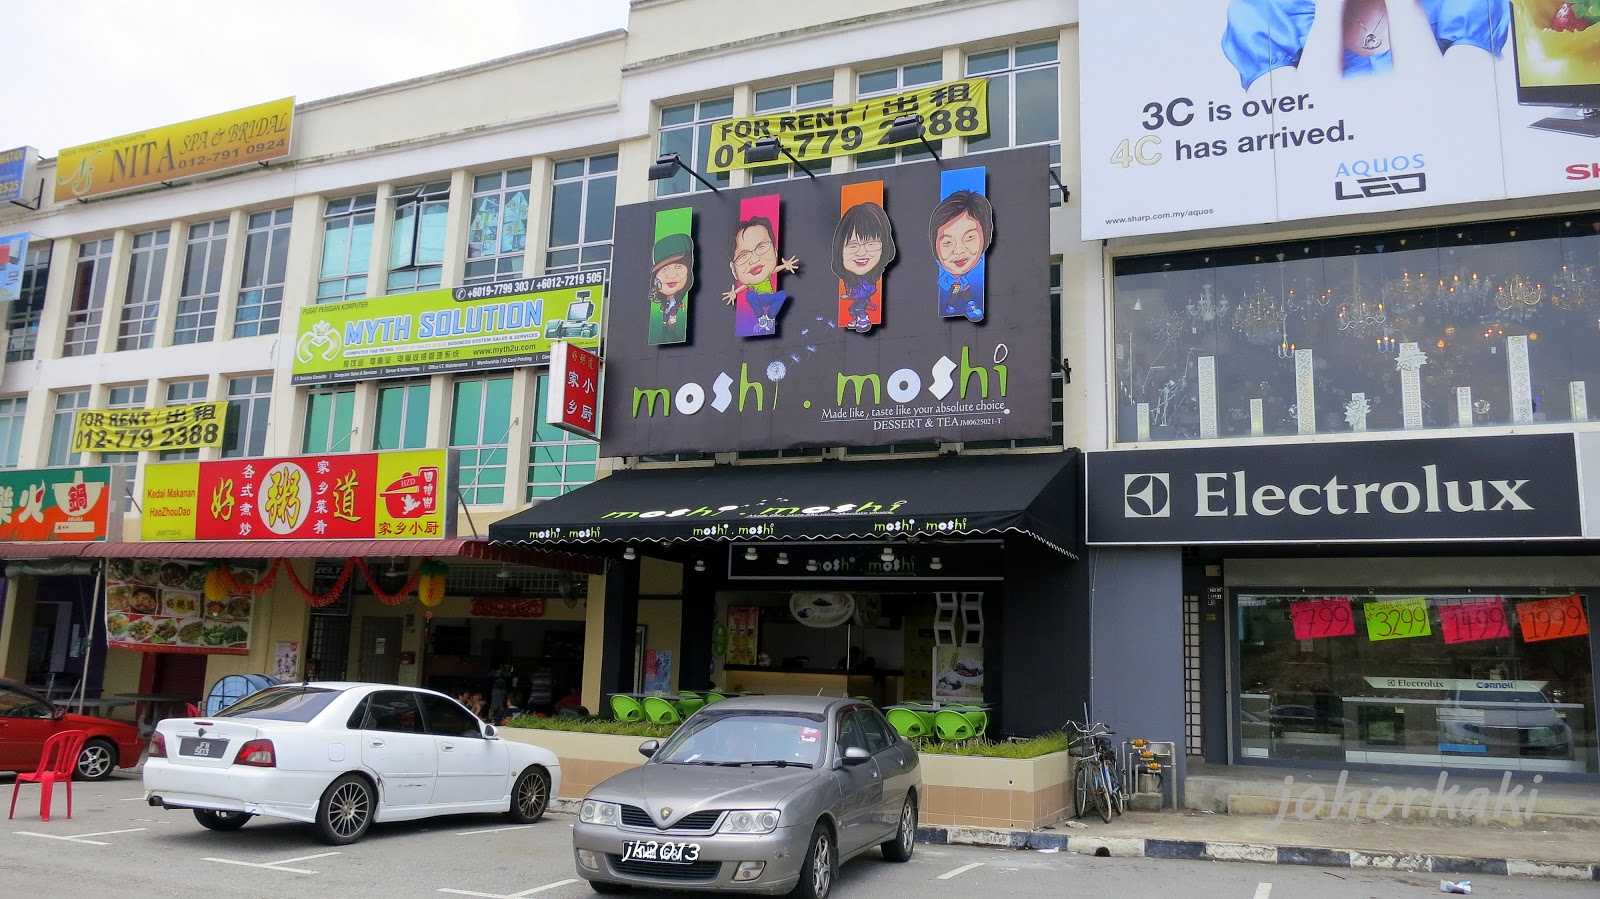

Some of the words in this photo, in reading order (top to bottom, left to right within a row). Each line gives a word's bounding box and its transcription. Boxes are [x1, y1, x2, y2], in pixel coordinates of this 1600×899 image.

[882, 83, 972, 116] 出租
[1141, 97, 1195, 131] 3C
[1207, 101, 1233, 123] is
[1241, 91, 1315, 118] over.
[179, 130, 208, 155] SPA
[228, 112, 288, 144] BRIDAL
[721, 119, 771, 142] FOR
[780, 106, 852, 132] RENT
[178, 148, 240, 169] 012-791
[246, 138, 286, 155] 0924
[1109, 135, 1163, 169] 4C
[1174, 135, 1228, 161] has
[1237, 120, 1355, 152] arrived.
[109, 137, 175, 183] NITA
[1334, 153, 1426, 179] AQUOS
[1334, 172, 1427, 201] LED
[1104, 206, 1214, 226] www.sharp.com.my/aquos
[467, 283, 513, 298] +6019-7799
[514, 280, 529, 293] 303
[536, 273, 585, 290] +6012-7219
[586, 272, 602, 283] 505
[341, 301, 369, 310] KOMPUTER
[344, 315, 412, 346] MYTH
[418, 299, 543, 339] SOLUTION
[514, 332, 539, 340] SERVICES
[473, 344, 536, 356] www.myth2u.com
[632, 361, 787, 418] moshi
[836, 343, 1009, 406] moshi
[80, 412, 104, 427] FOR
[109, 411, 152, 427] RENT
[166, 404, 216, 424] 出租
[821, 408, 847, 420] Made
[871, 407, 894, 417] taste
[896, 405, 912, 416] like
[913, 406, 933, 419] your
[935, 401, 974, 413] absolute
[75, 428, 153, 450] 012-779
[161, 423, 219, 447] 2388
[873, 419, 922, 431] DESSERT
[924, 418, 934, 428] &
[937, 417, 959, 428] TEA
[147, 489, 166, 498] Kedai
[167, 488, 196, 498] Makanan
[400, 478, 416, 487] HZD
[1193, 464, 1536, 518] Electrolux
[149, 506, 191, 517] HaoZhouDao
[601, 505, 739, 519] moshi
[760, 500, 908, 516] moshi
[378, 521, 439, 536] 家乡小厨
[529, 527, 561, 539] moshi
[569, 526, 601, 538] moshi
[693, 523, 729, 537] moshi
[738, 522, 775, 535] moshi
[874, 519, 915, 531] moshi
[926, 518, 967, 530] moshi
[1302, 607, 1349, 636] 799
[1376, 606, 1426, 637] 3299
[1451, 607, 1504, 641] 1499
[1528, 605, 1581, 640] 1999
[1398, 679, 1444, 688] Electrolux
